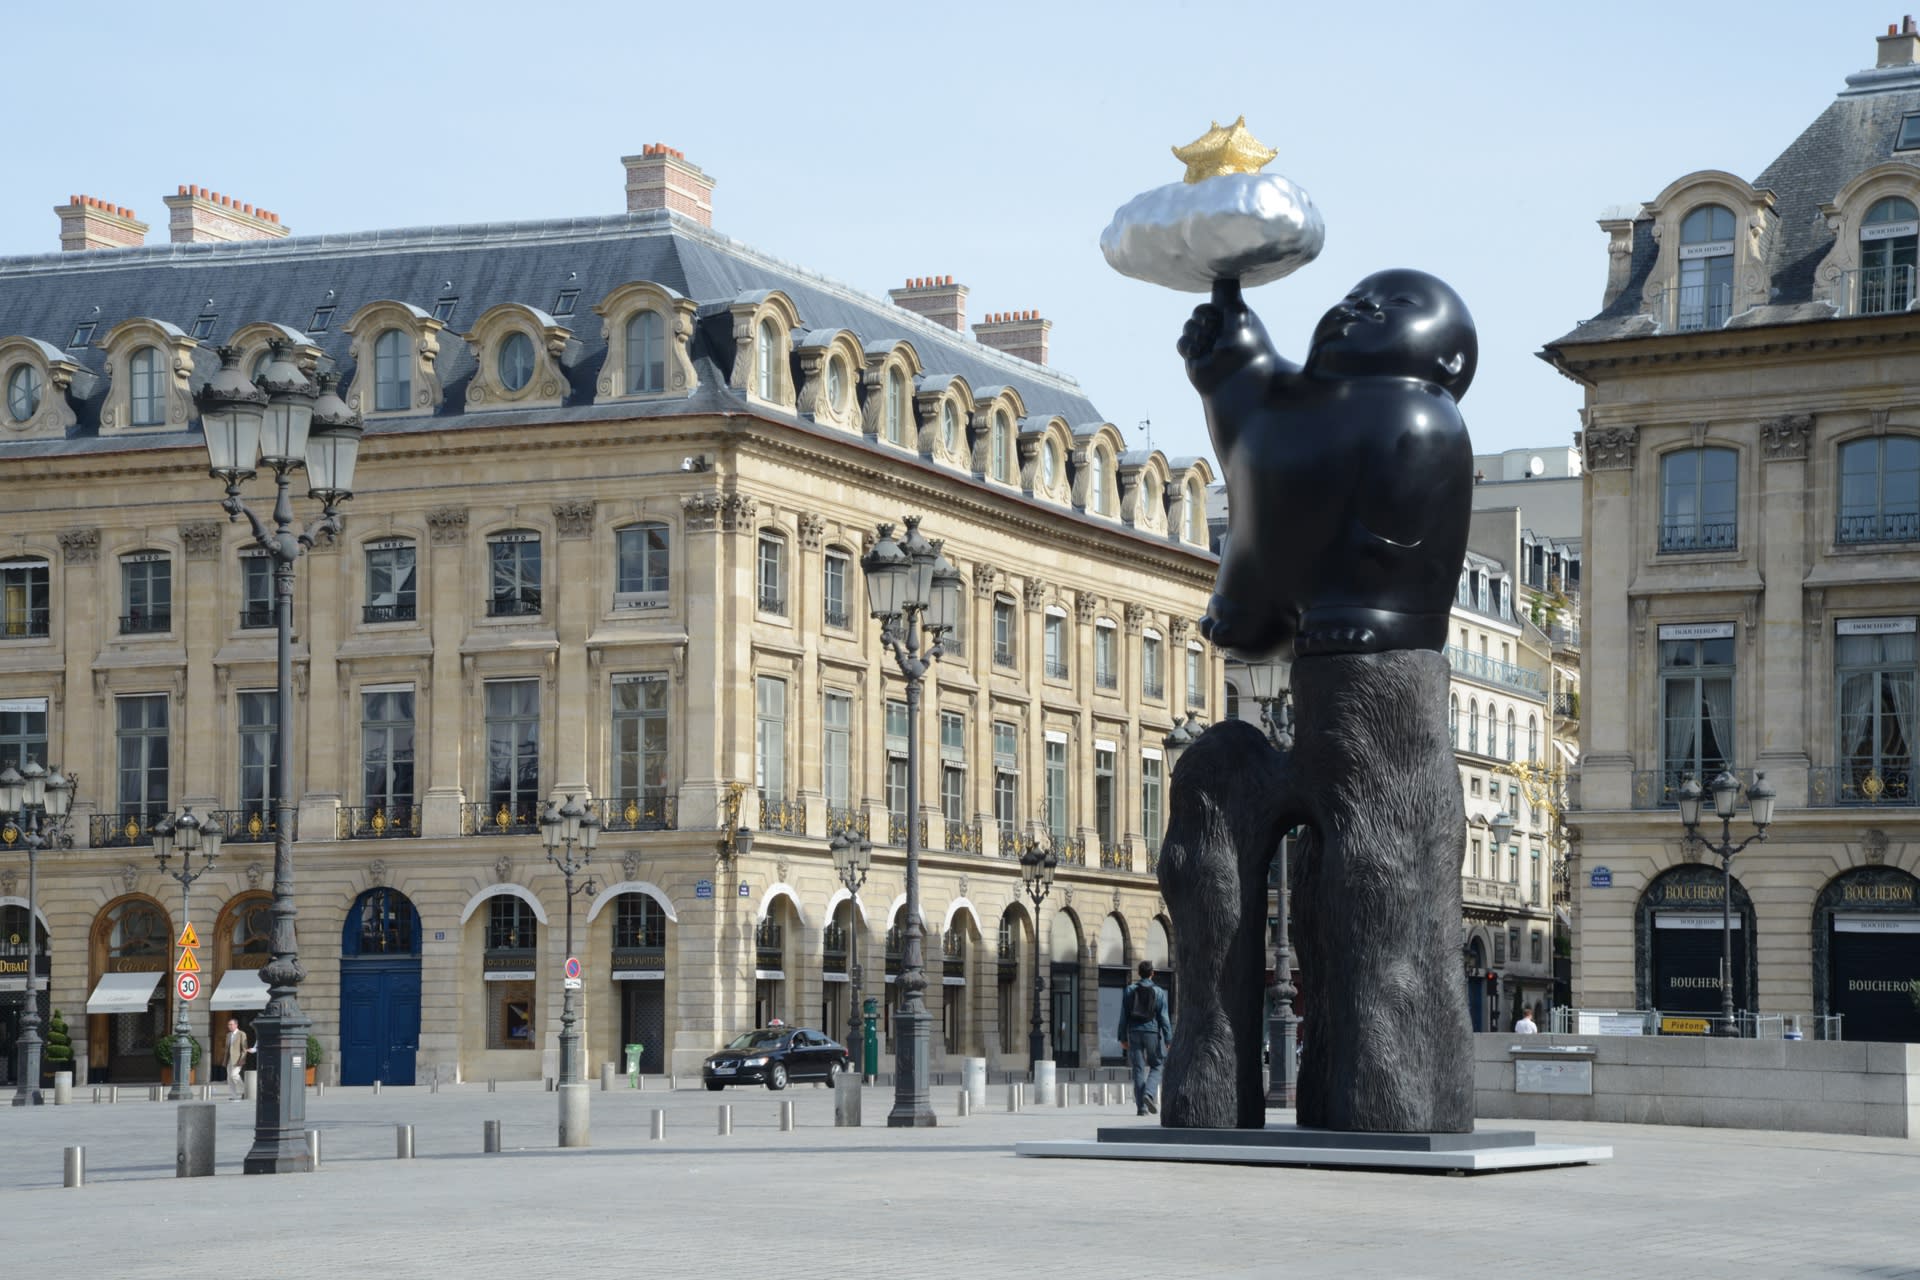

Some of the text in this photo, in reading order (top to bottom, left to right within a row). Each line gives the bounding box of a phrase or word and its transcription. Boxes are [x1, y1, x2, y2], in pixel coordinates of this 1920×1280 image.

[1844, 885, 1912, 901] BOUCHERON
[182, 980, 195, 992] 30
[1670, 1020, 1705, 1030] Piétons
